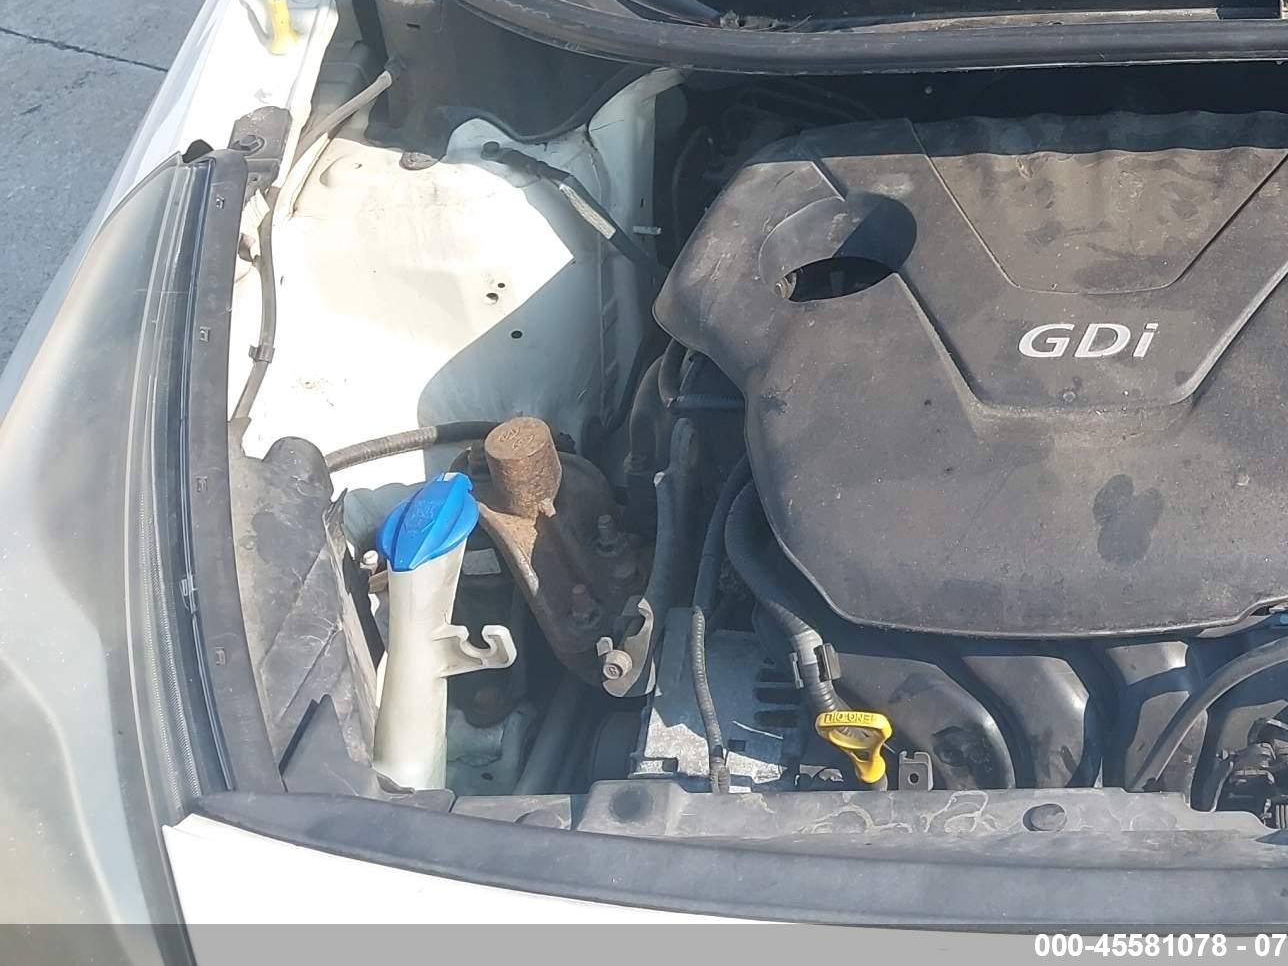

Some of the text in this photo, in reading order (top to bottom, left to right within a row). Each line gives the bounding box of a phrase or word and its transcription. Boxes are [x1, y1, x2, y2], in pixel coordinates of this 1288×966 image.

[1017, 322, 1160, 358] GDi
[825, 713, 873, 723] ENG OIL
